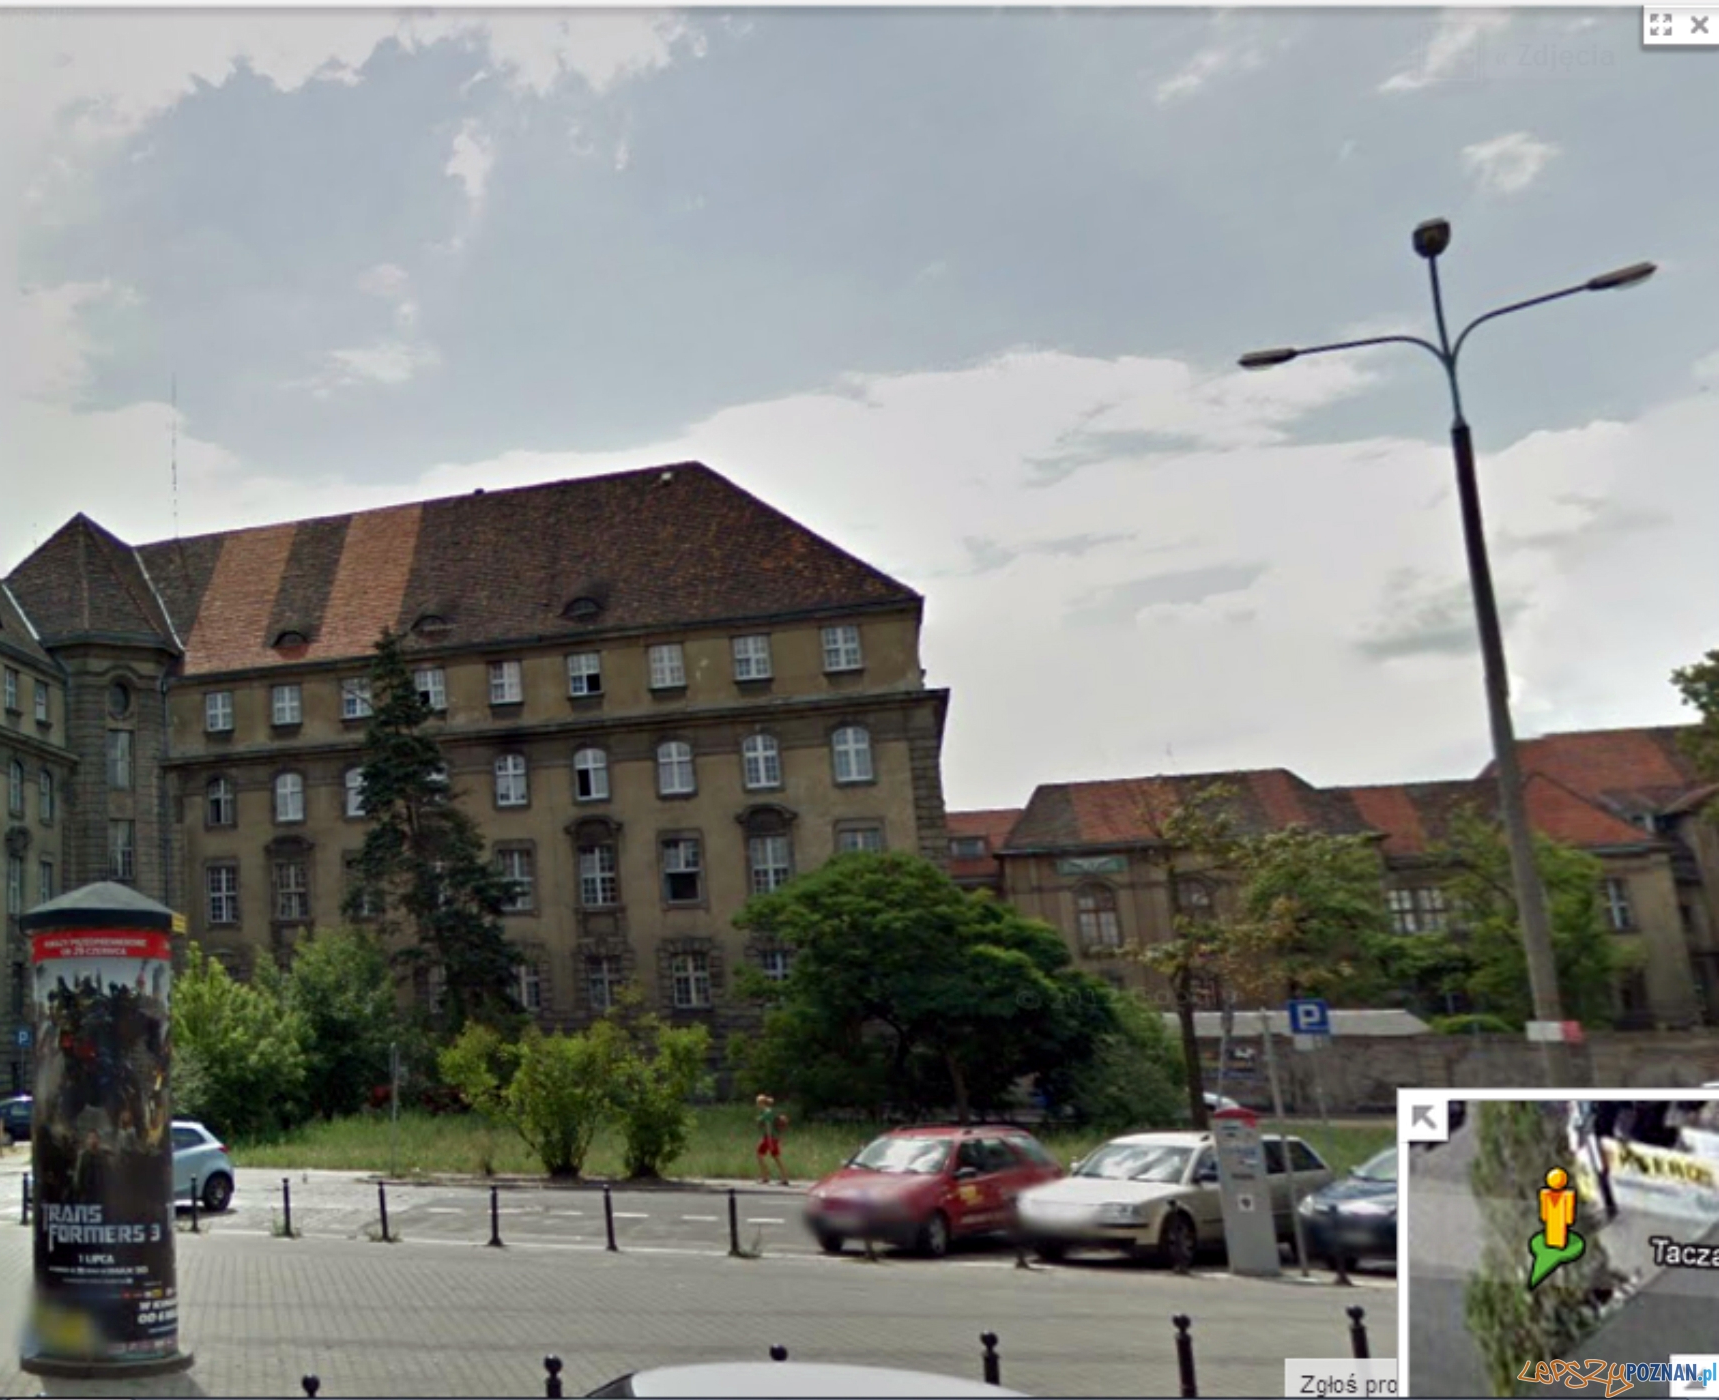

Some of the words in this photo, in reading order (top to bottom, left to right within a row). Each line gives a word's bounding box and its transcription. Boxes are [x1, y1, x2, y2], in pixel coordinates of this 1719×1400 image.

[1297, 1006, 1320, 1029] P
[42, 1203, 103, 1231] TRANS
[49, 1223, 146, 1252] FORMERS
[150, 1223, 161, 1242] 3
